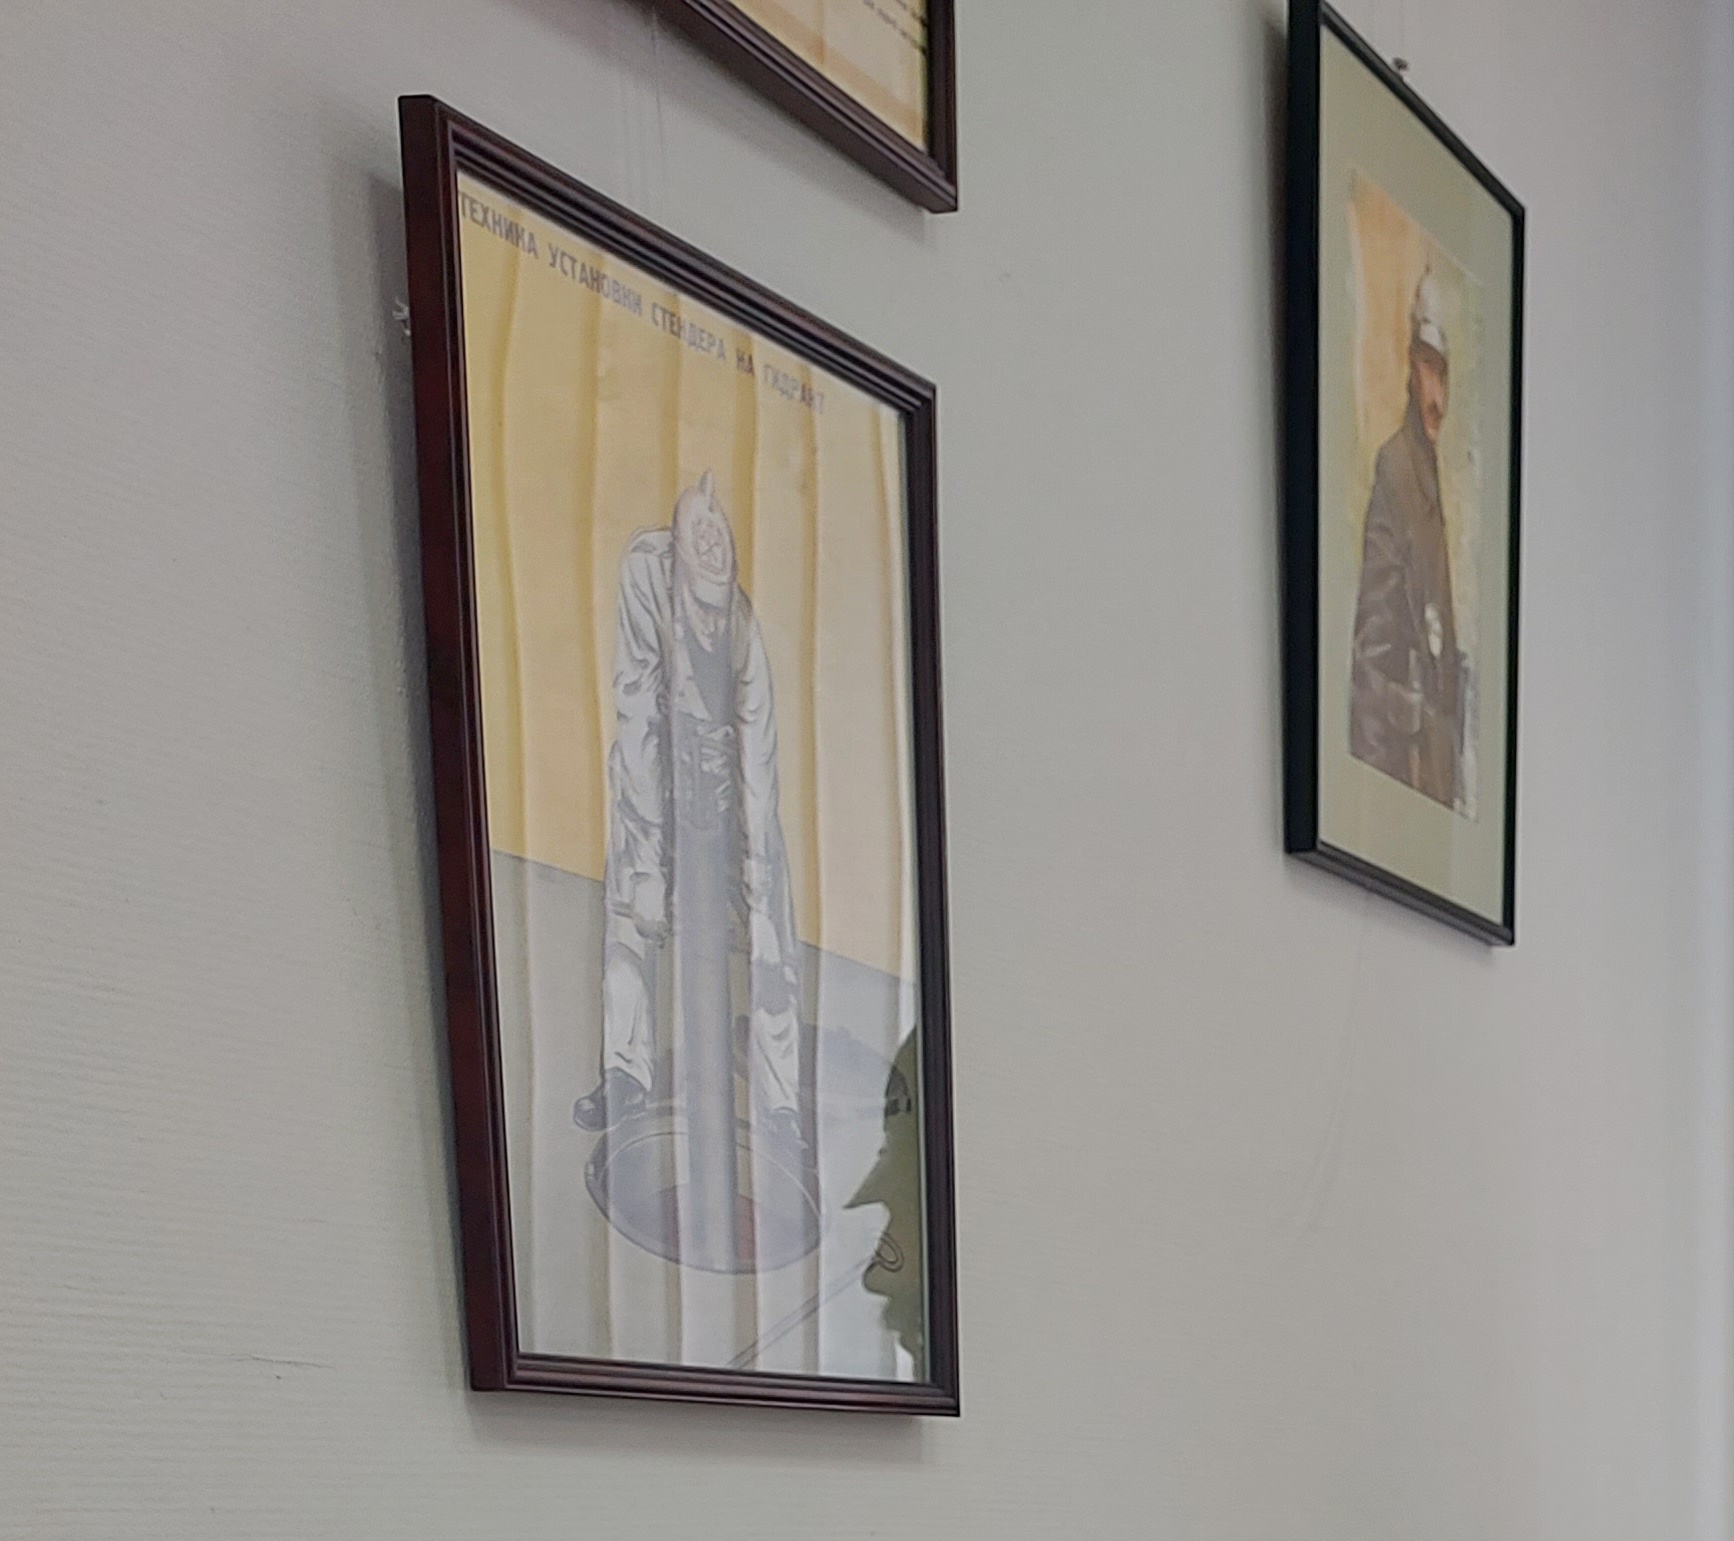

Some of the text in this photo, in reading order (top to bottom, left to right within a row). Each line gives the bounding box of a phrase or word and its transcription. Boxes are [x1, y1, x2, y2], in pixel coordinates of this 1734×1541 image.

[460, 192, 539, 259] ТЕХНИКА
[547, 243, 643, 316] УСТАНОВКИ
[735, 348, 755, 376] НА
